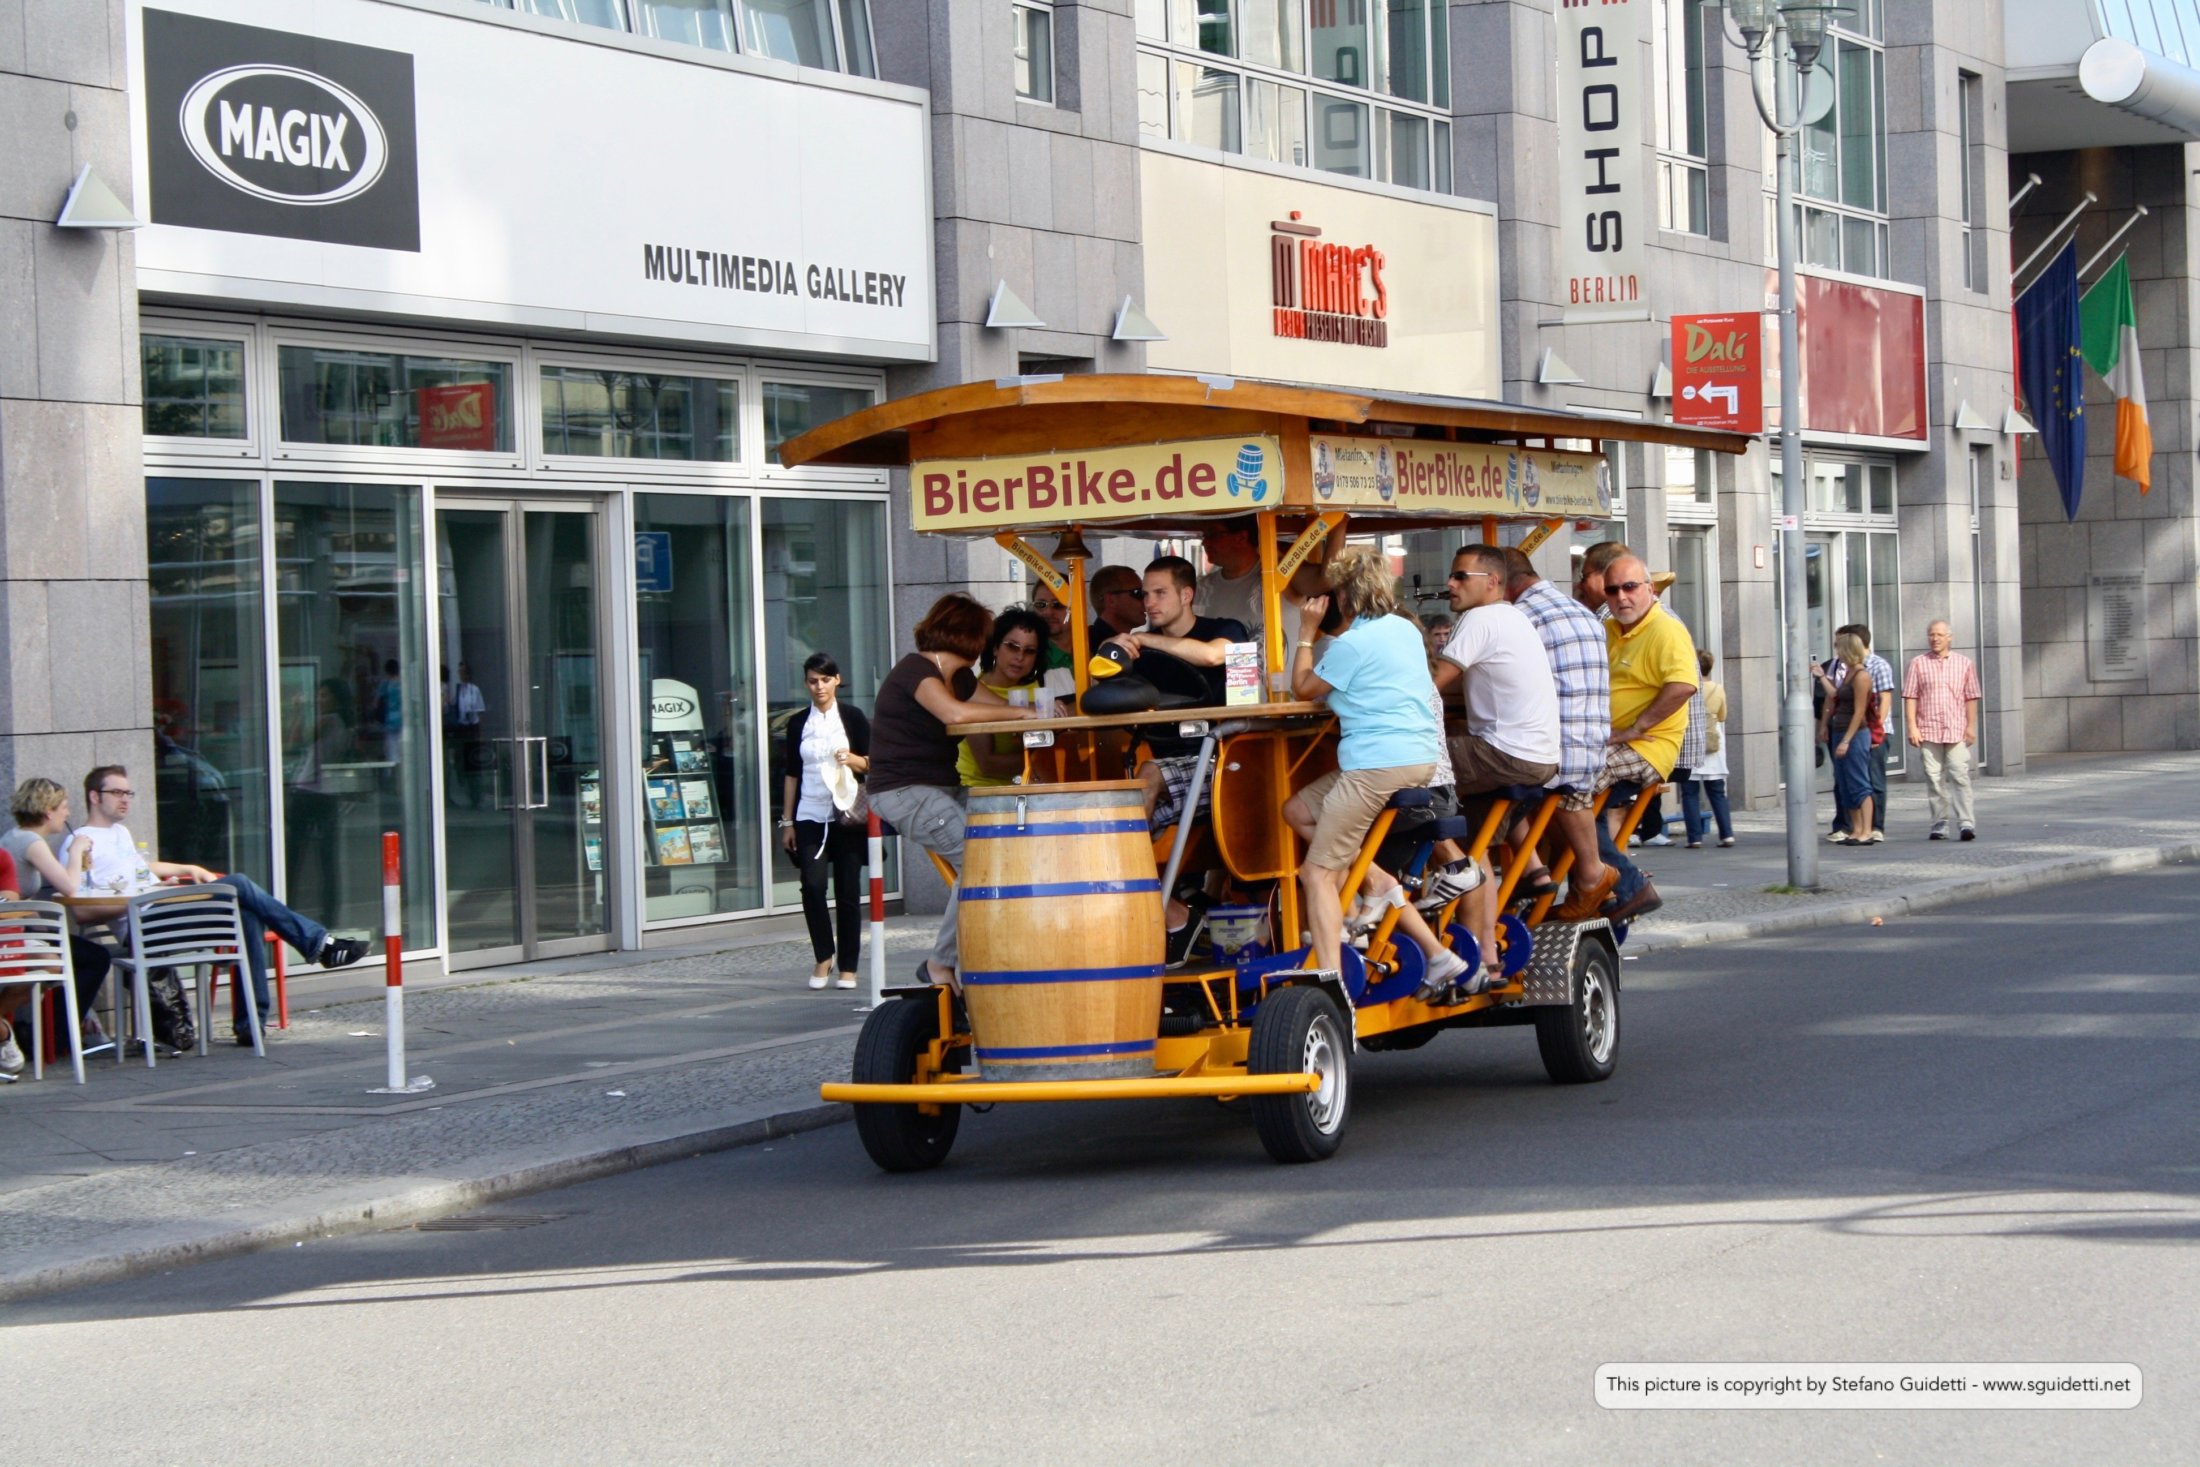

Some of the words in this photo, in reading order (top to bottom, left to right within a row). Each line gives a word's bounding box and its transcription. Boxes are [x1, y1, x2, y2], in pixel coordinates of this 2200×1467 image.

[219, 99, 351, 172] MAGIX
[1580, 26, 1623, 254] SHOP
[643, 243, 799, 296] MULTIMEDIA
[806, 263, 906, 308] GALLERY
[1569, 274, 1639, 304] BERLIN
[1684, 323, 1748, 363] Dalí
[923, 453, 1217, 517] BierBike.de
[1396, 450, 1503, 499] BierBike.de
[1011, 542, 1055, 582] BierBike.de
[1279, 528, 1320, 576] BierBike.de
